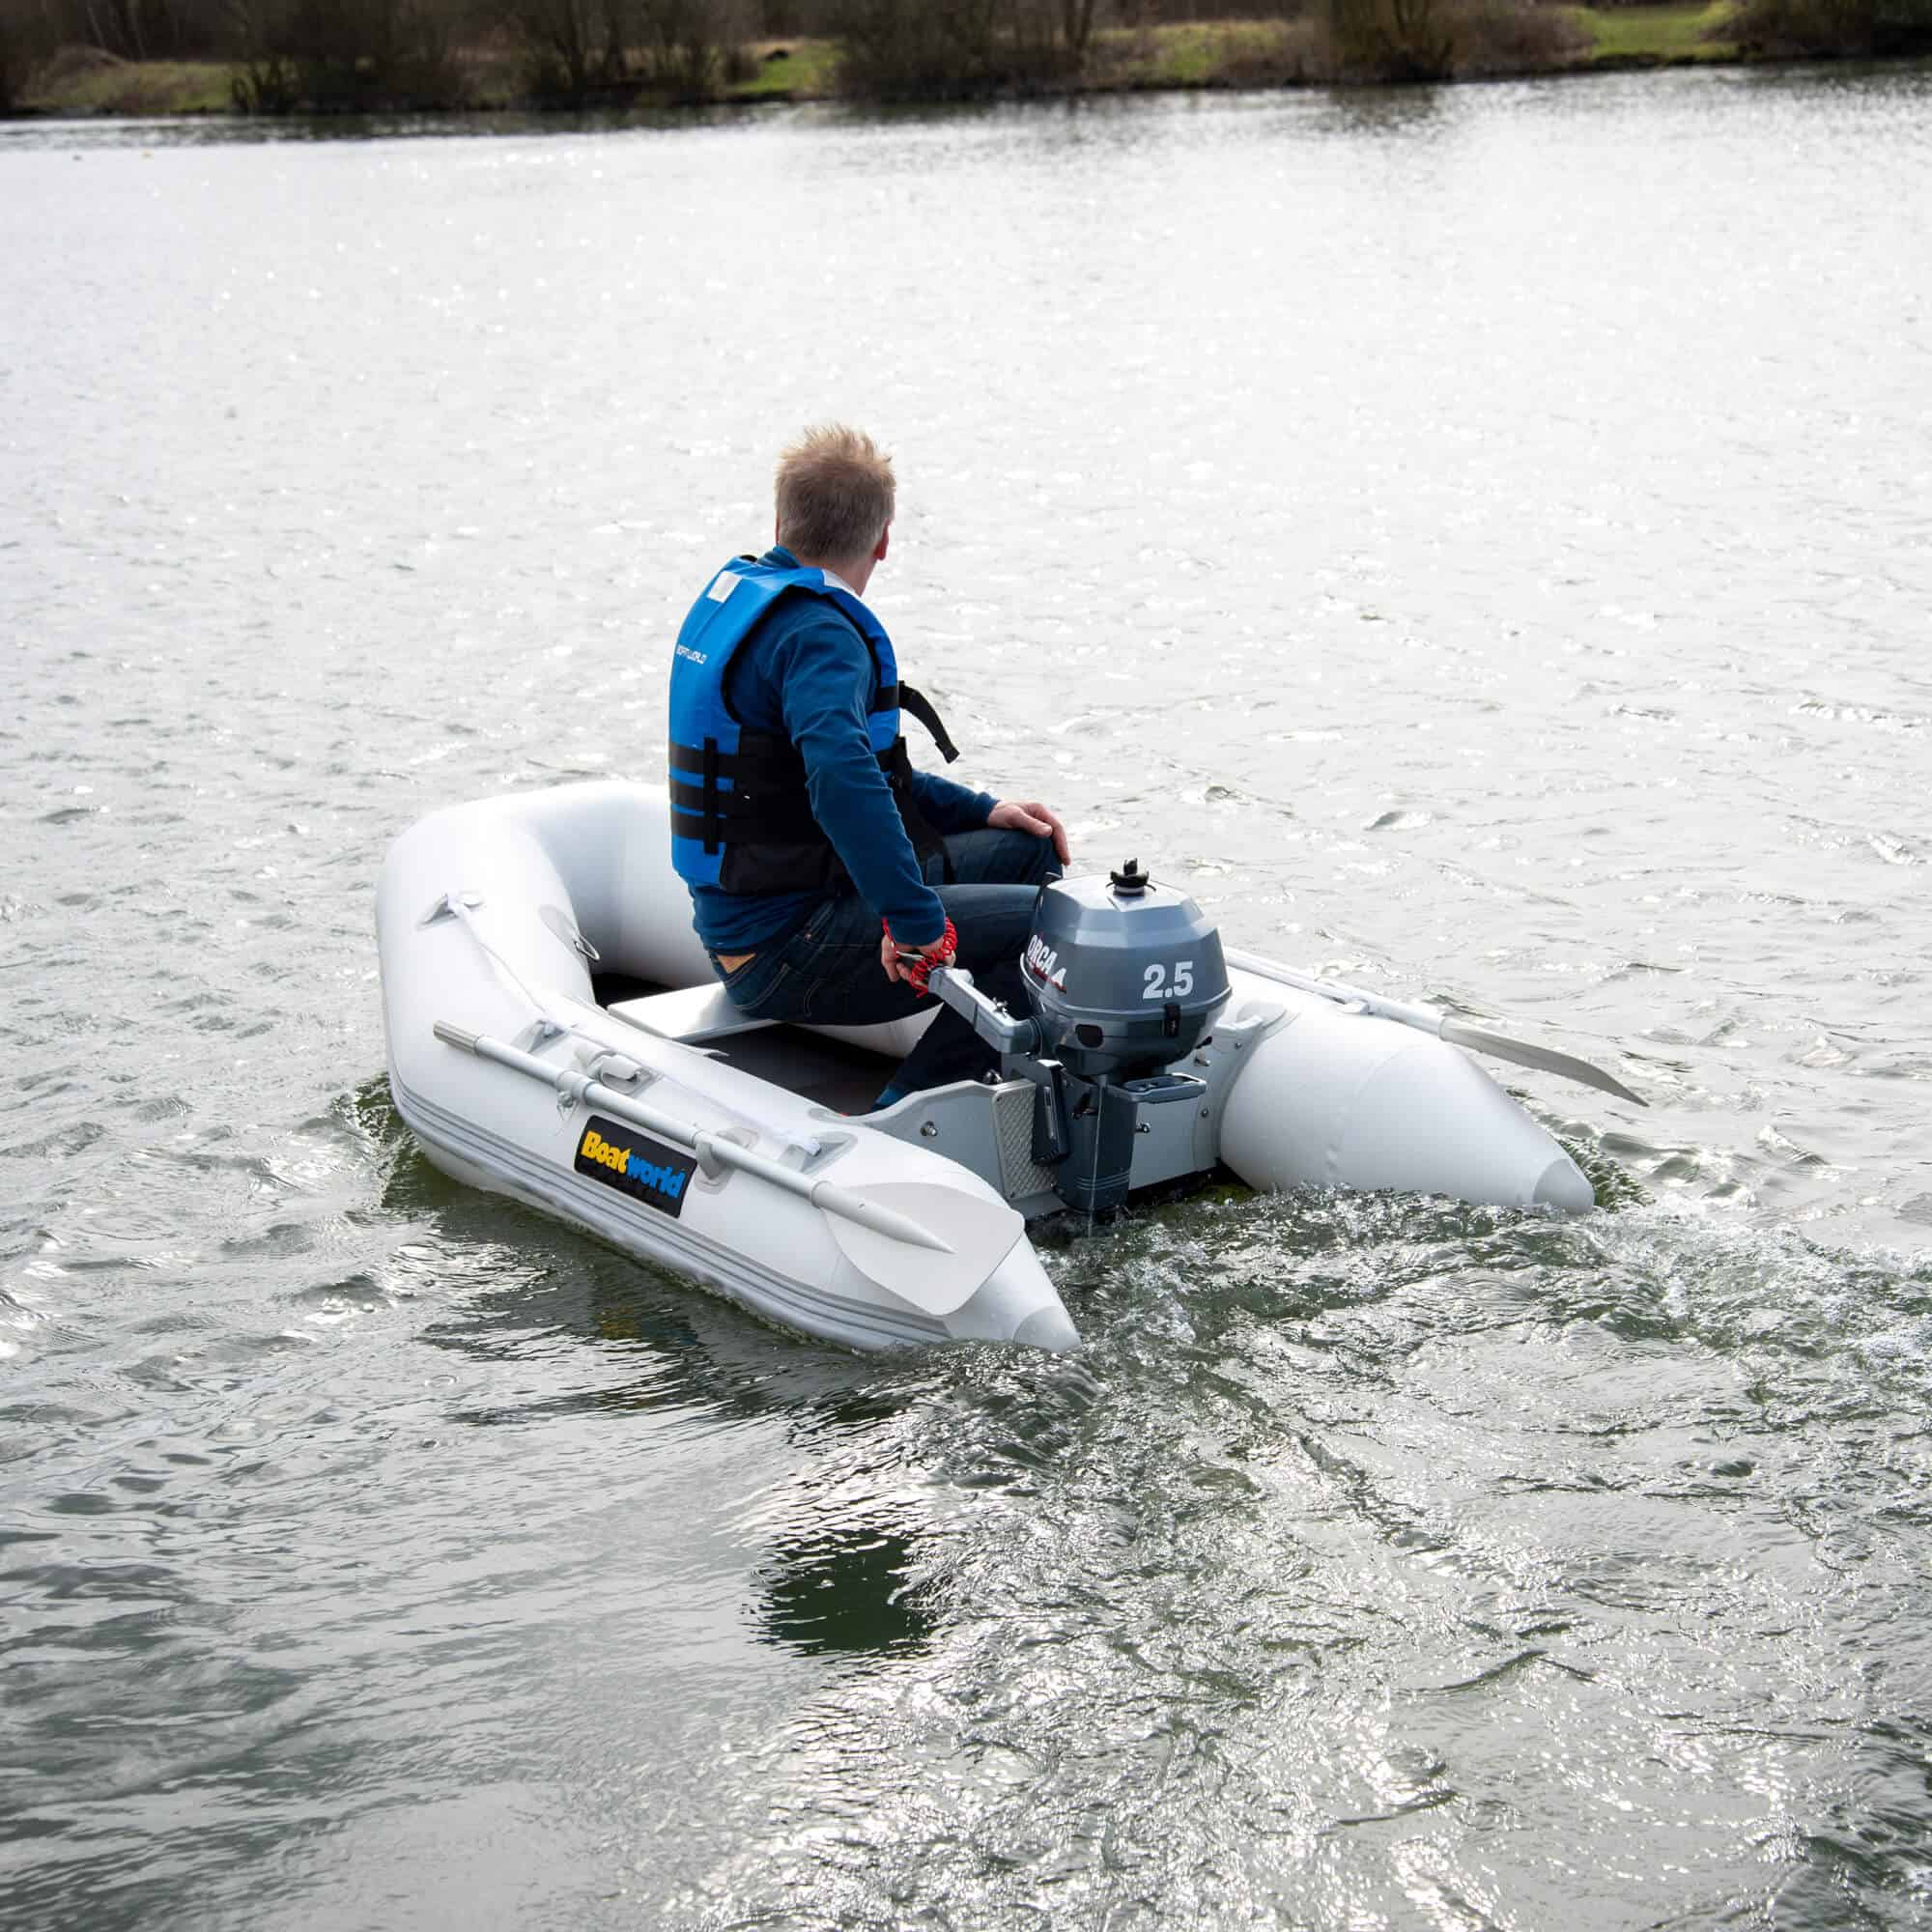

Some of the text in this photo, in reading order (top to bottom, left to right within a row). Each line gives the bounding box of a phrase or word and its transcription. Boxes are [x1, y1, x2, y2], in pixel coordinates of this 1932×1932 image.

[1027, 934, 1058, 975] ORCA
[1143, 961, 1193, 1000] 2.5
[581, 1130, 686, 1198] Boatworld
